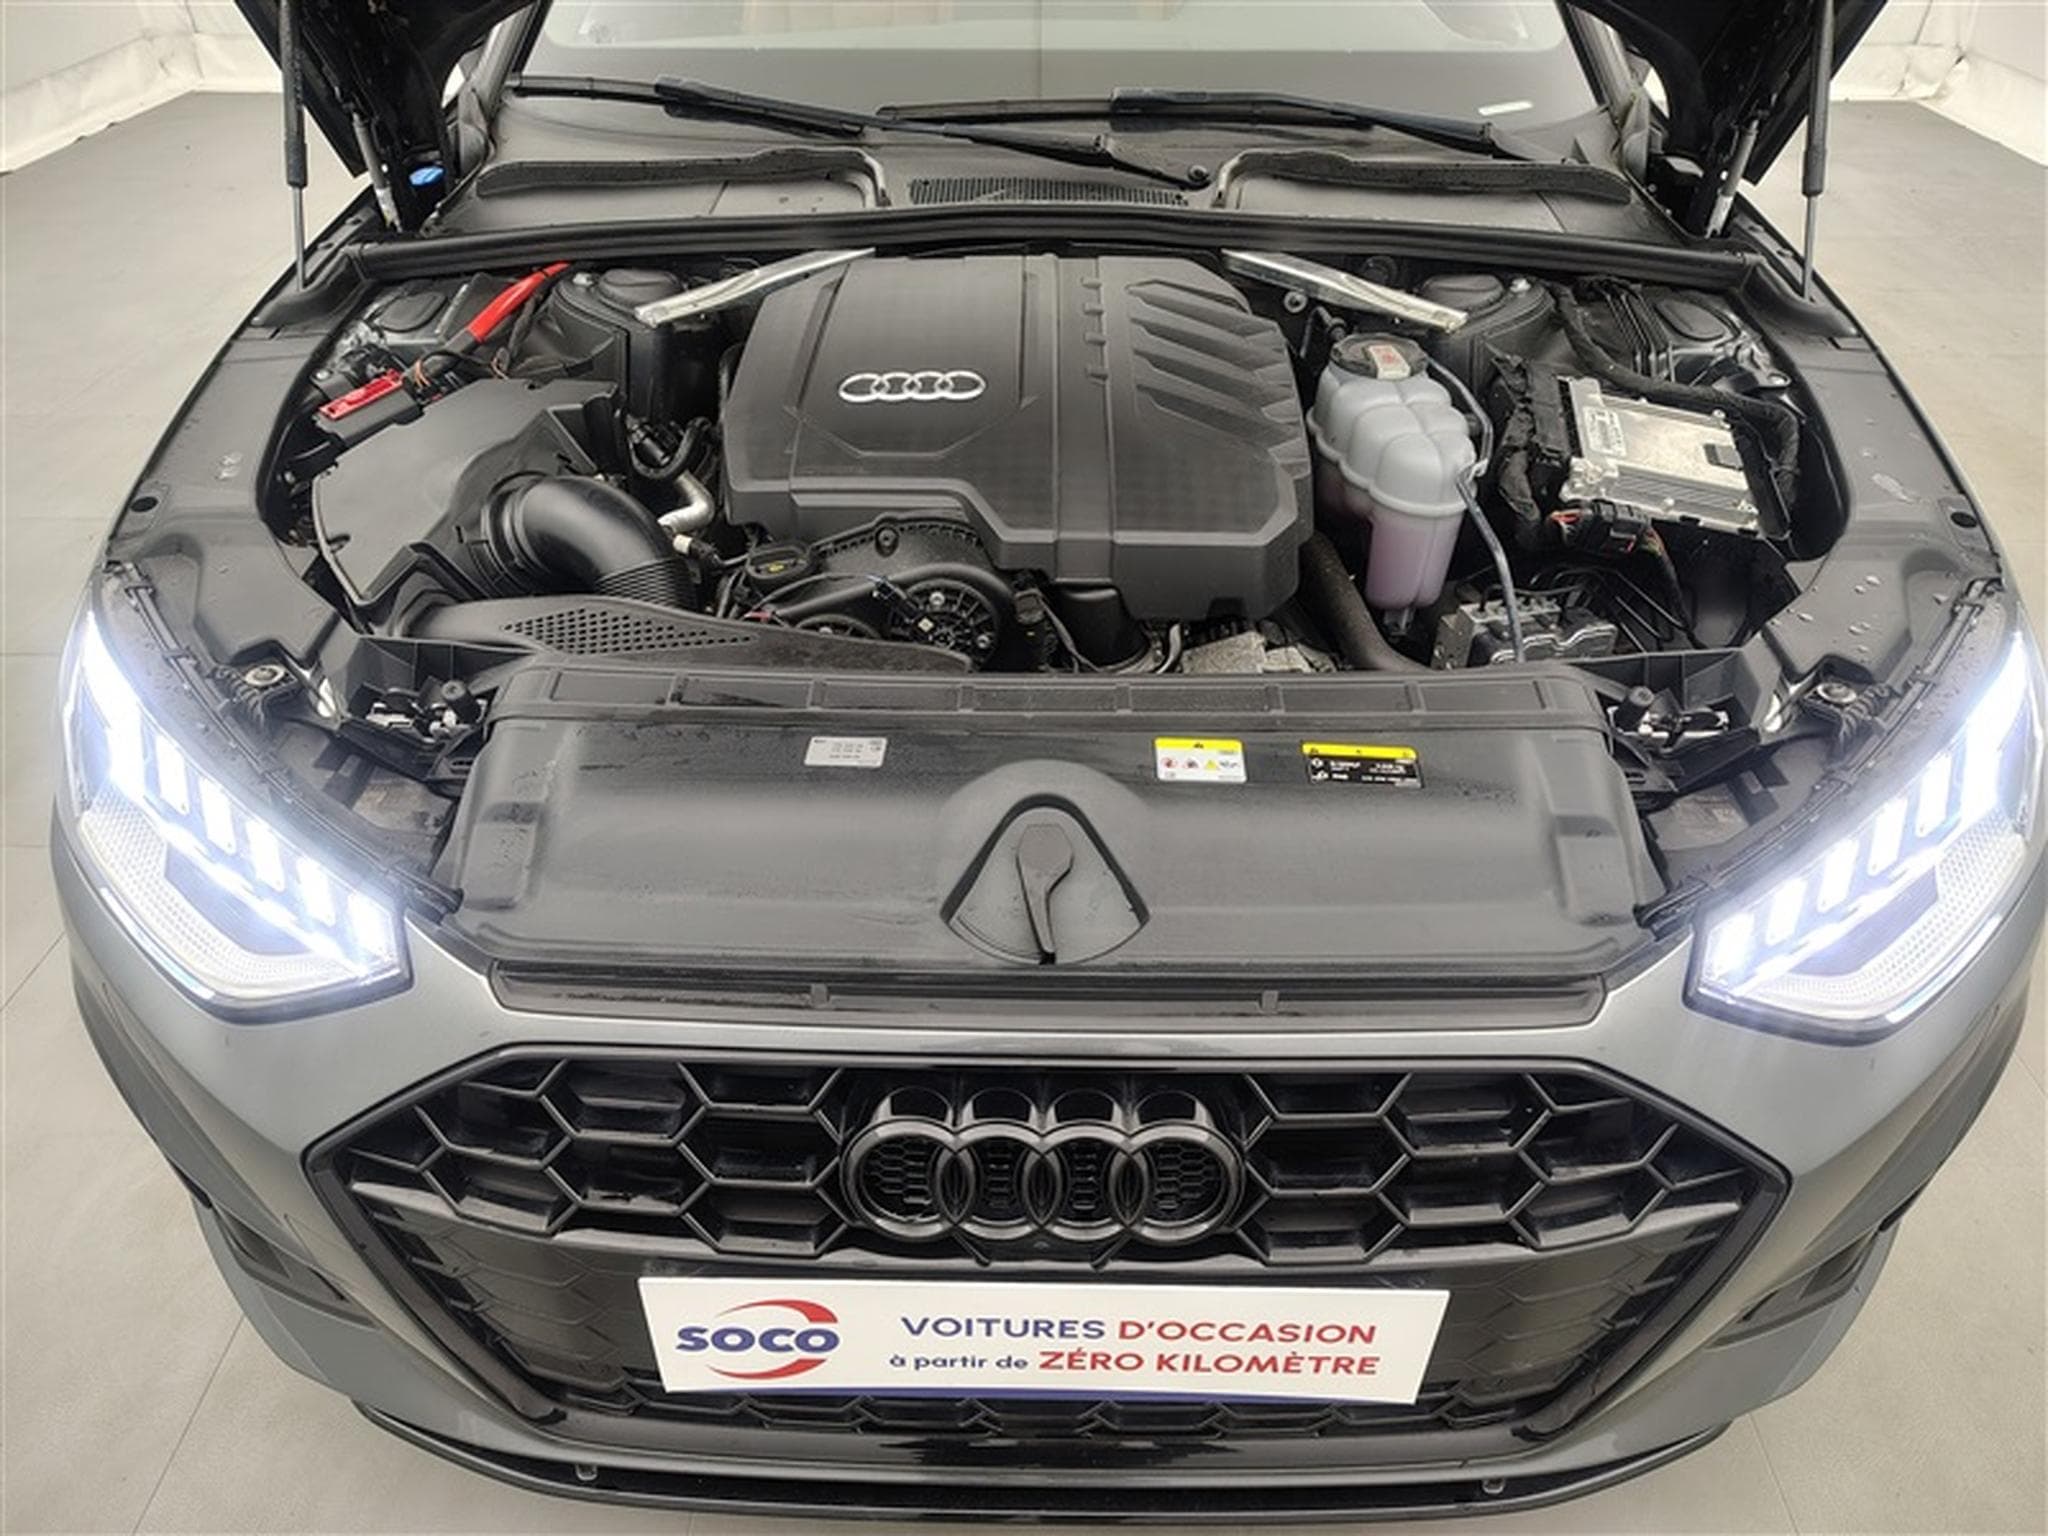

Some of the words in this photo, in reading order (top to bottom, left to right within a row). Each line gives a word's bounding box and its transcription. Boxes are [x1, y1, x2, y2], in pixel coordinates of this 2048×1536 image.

[675, 1326, 840, 1354] SOCO
[900, 1316, 1105, 1340] VOITURES
[1118, 1320, 1377, 1345] D'OCCASION
[889, 1354, 906, 1368] à
[914, 1356, 988, 1371] partir
[995, 1355, 1030, 1370] de
[1039, 1346, 1145, 1372] ZÉRO
[1156, 1350, 1381, 1376] KILOMÈTRE
